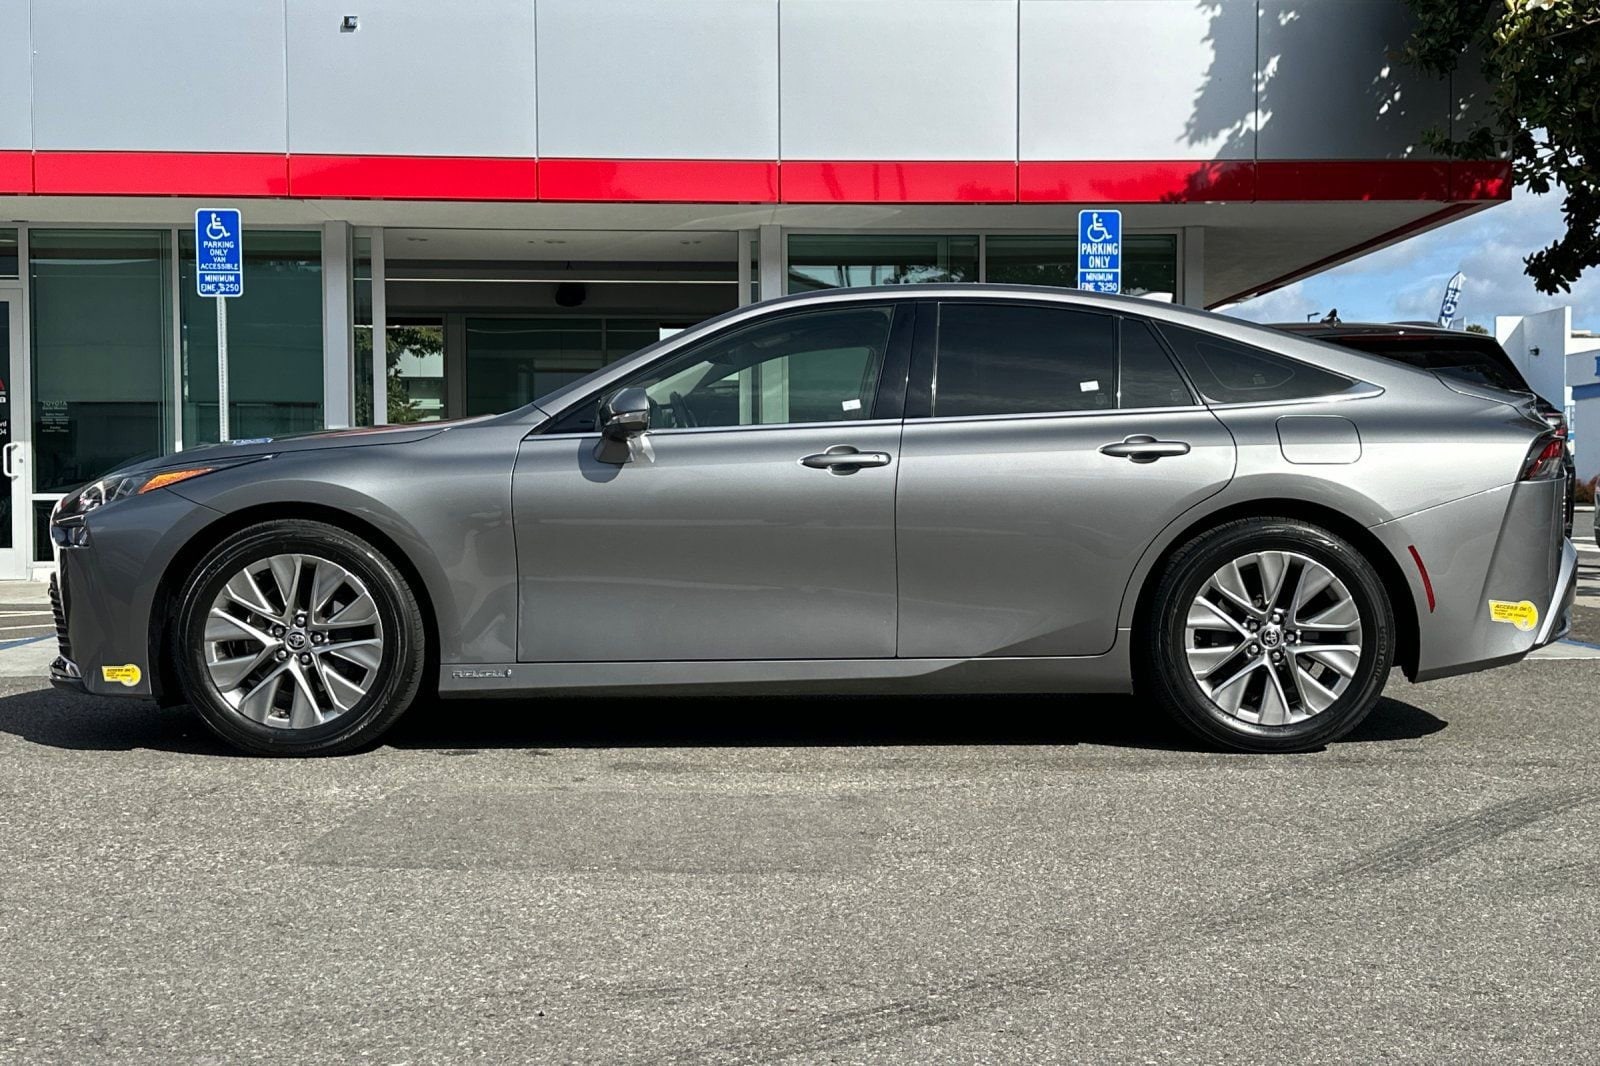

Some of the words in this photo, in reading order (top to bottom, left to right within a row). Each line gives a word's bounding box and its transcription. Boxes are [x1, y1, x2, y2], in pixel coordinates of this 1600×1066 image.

[203, 241, 235, 249] PARKING
[1081, 243, 1118, 255] PARKING
[209, 248, 228, 256] ONLY
[1088, 256, 1110, 268] ONLY
[204, 274, 235, 282] MINIMUM
[1085, 273, 1113, 281] MINIMUM
[1081, 282, 1096, 291] FINE
[1098, 282, 1118, 292] $250
